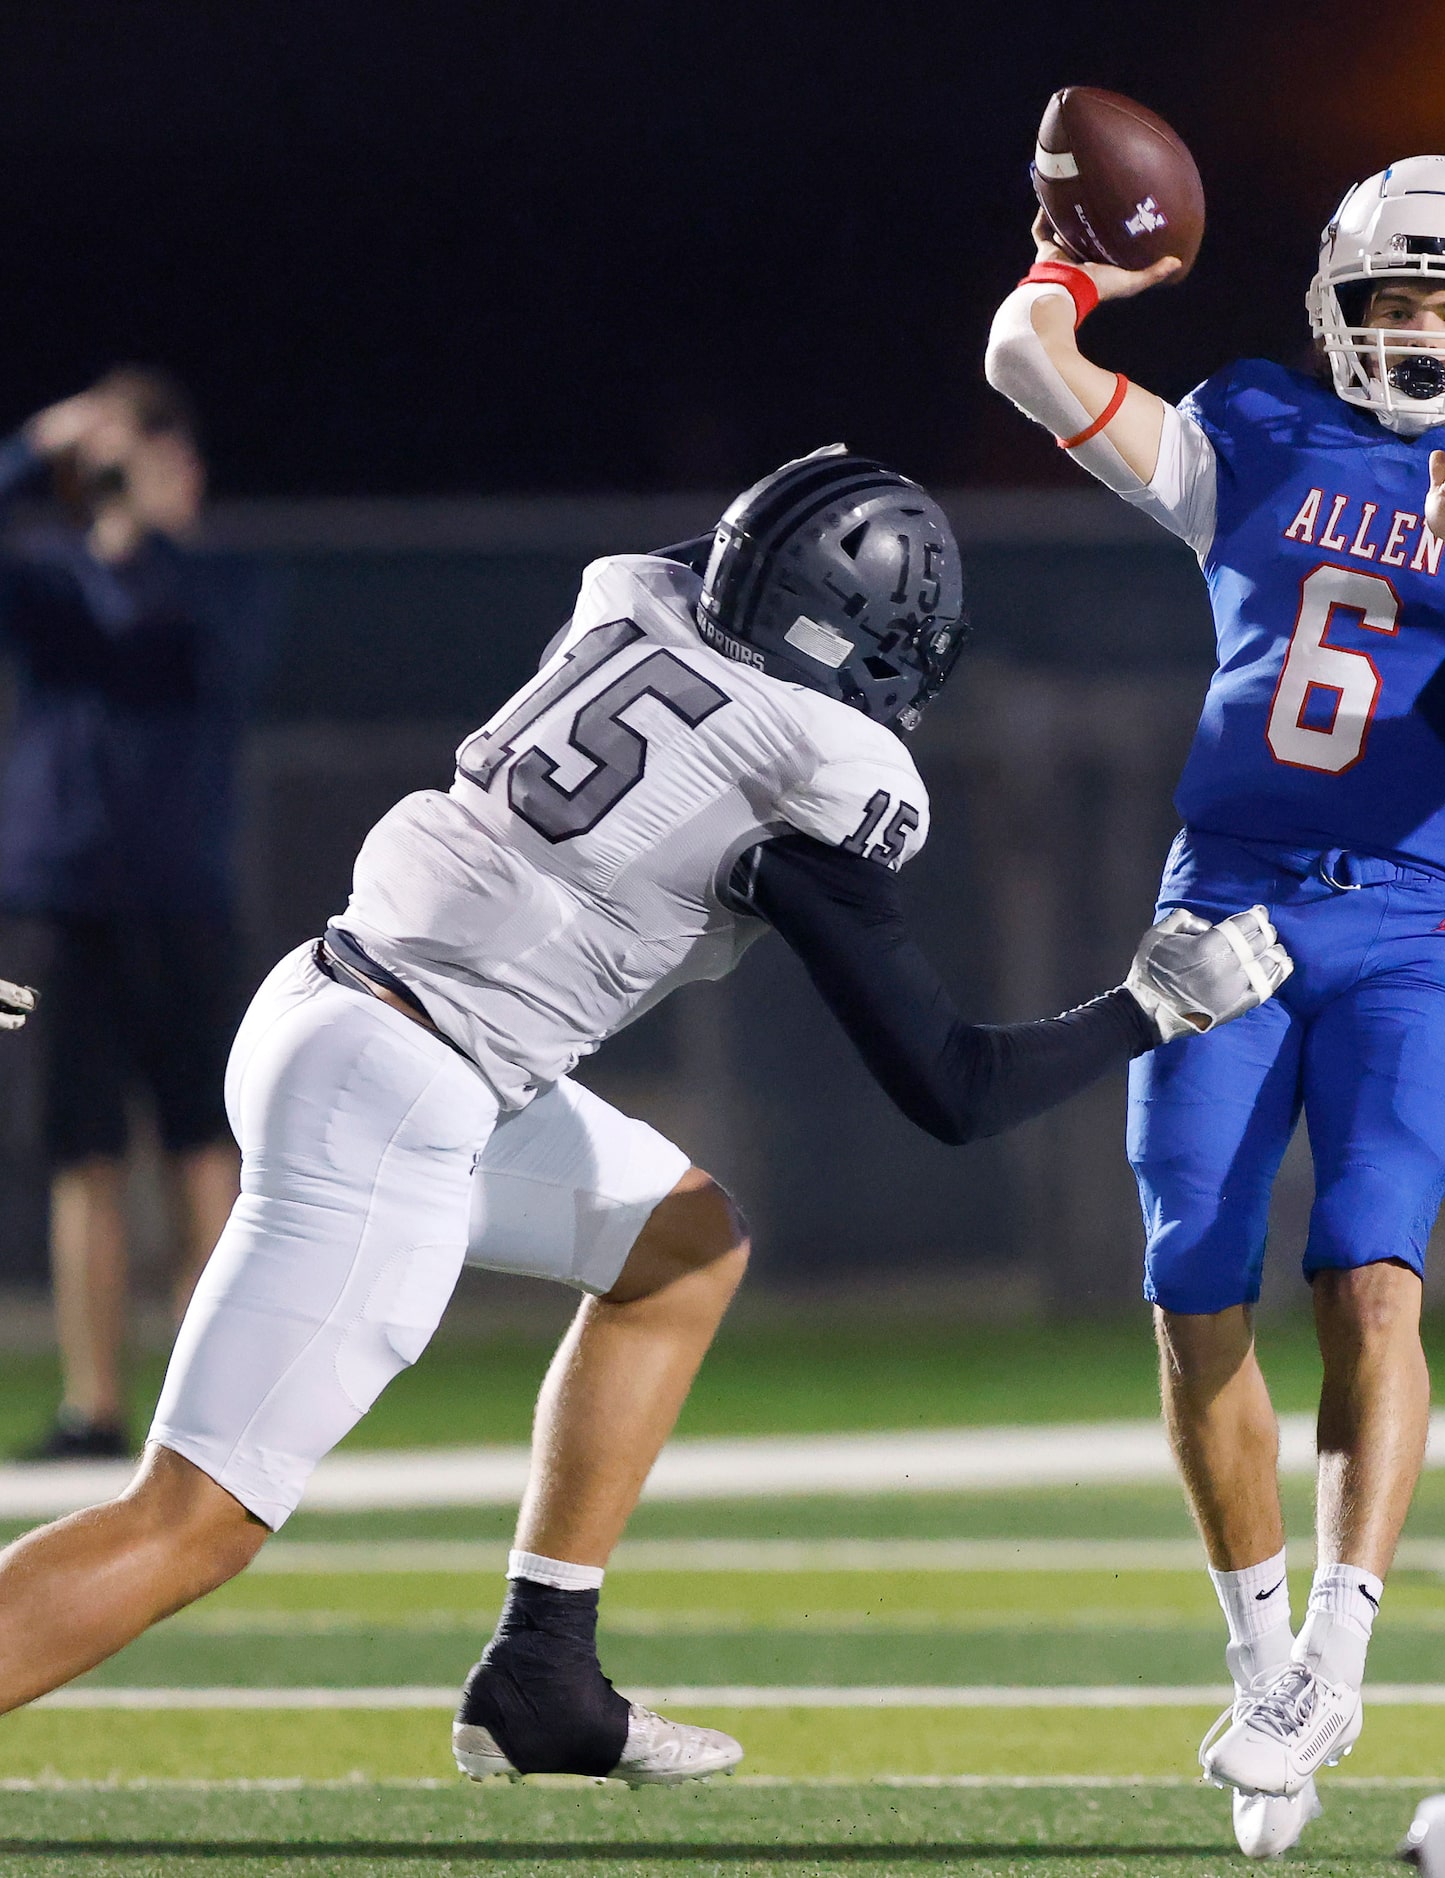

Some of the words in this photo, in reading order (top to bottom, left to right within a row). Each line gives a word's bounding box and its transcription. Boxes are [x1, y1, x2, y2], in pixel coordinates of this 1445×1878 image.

[889, 534, 943, 614] 15
[457, 617, 733, 845] 15
[1265, 561, 1404, 777] 6
[839, 788, 920, 867] 15
